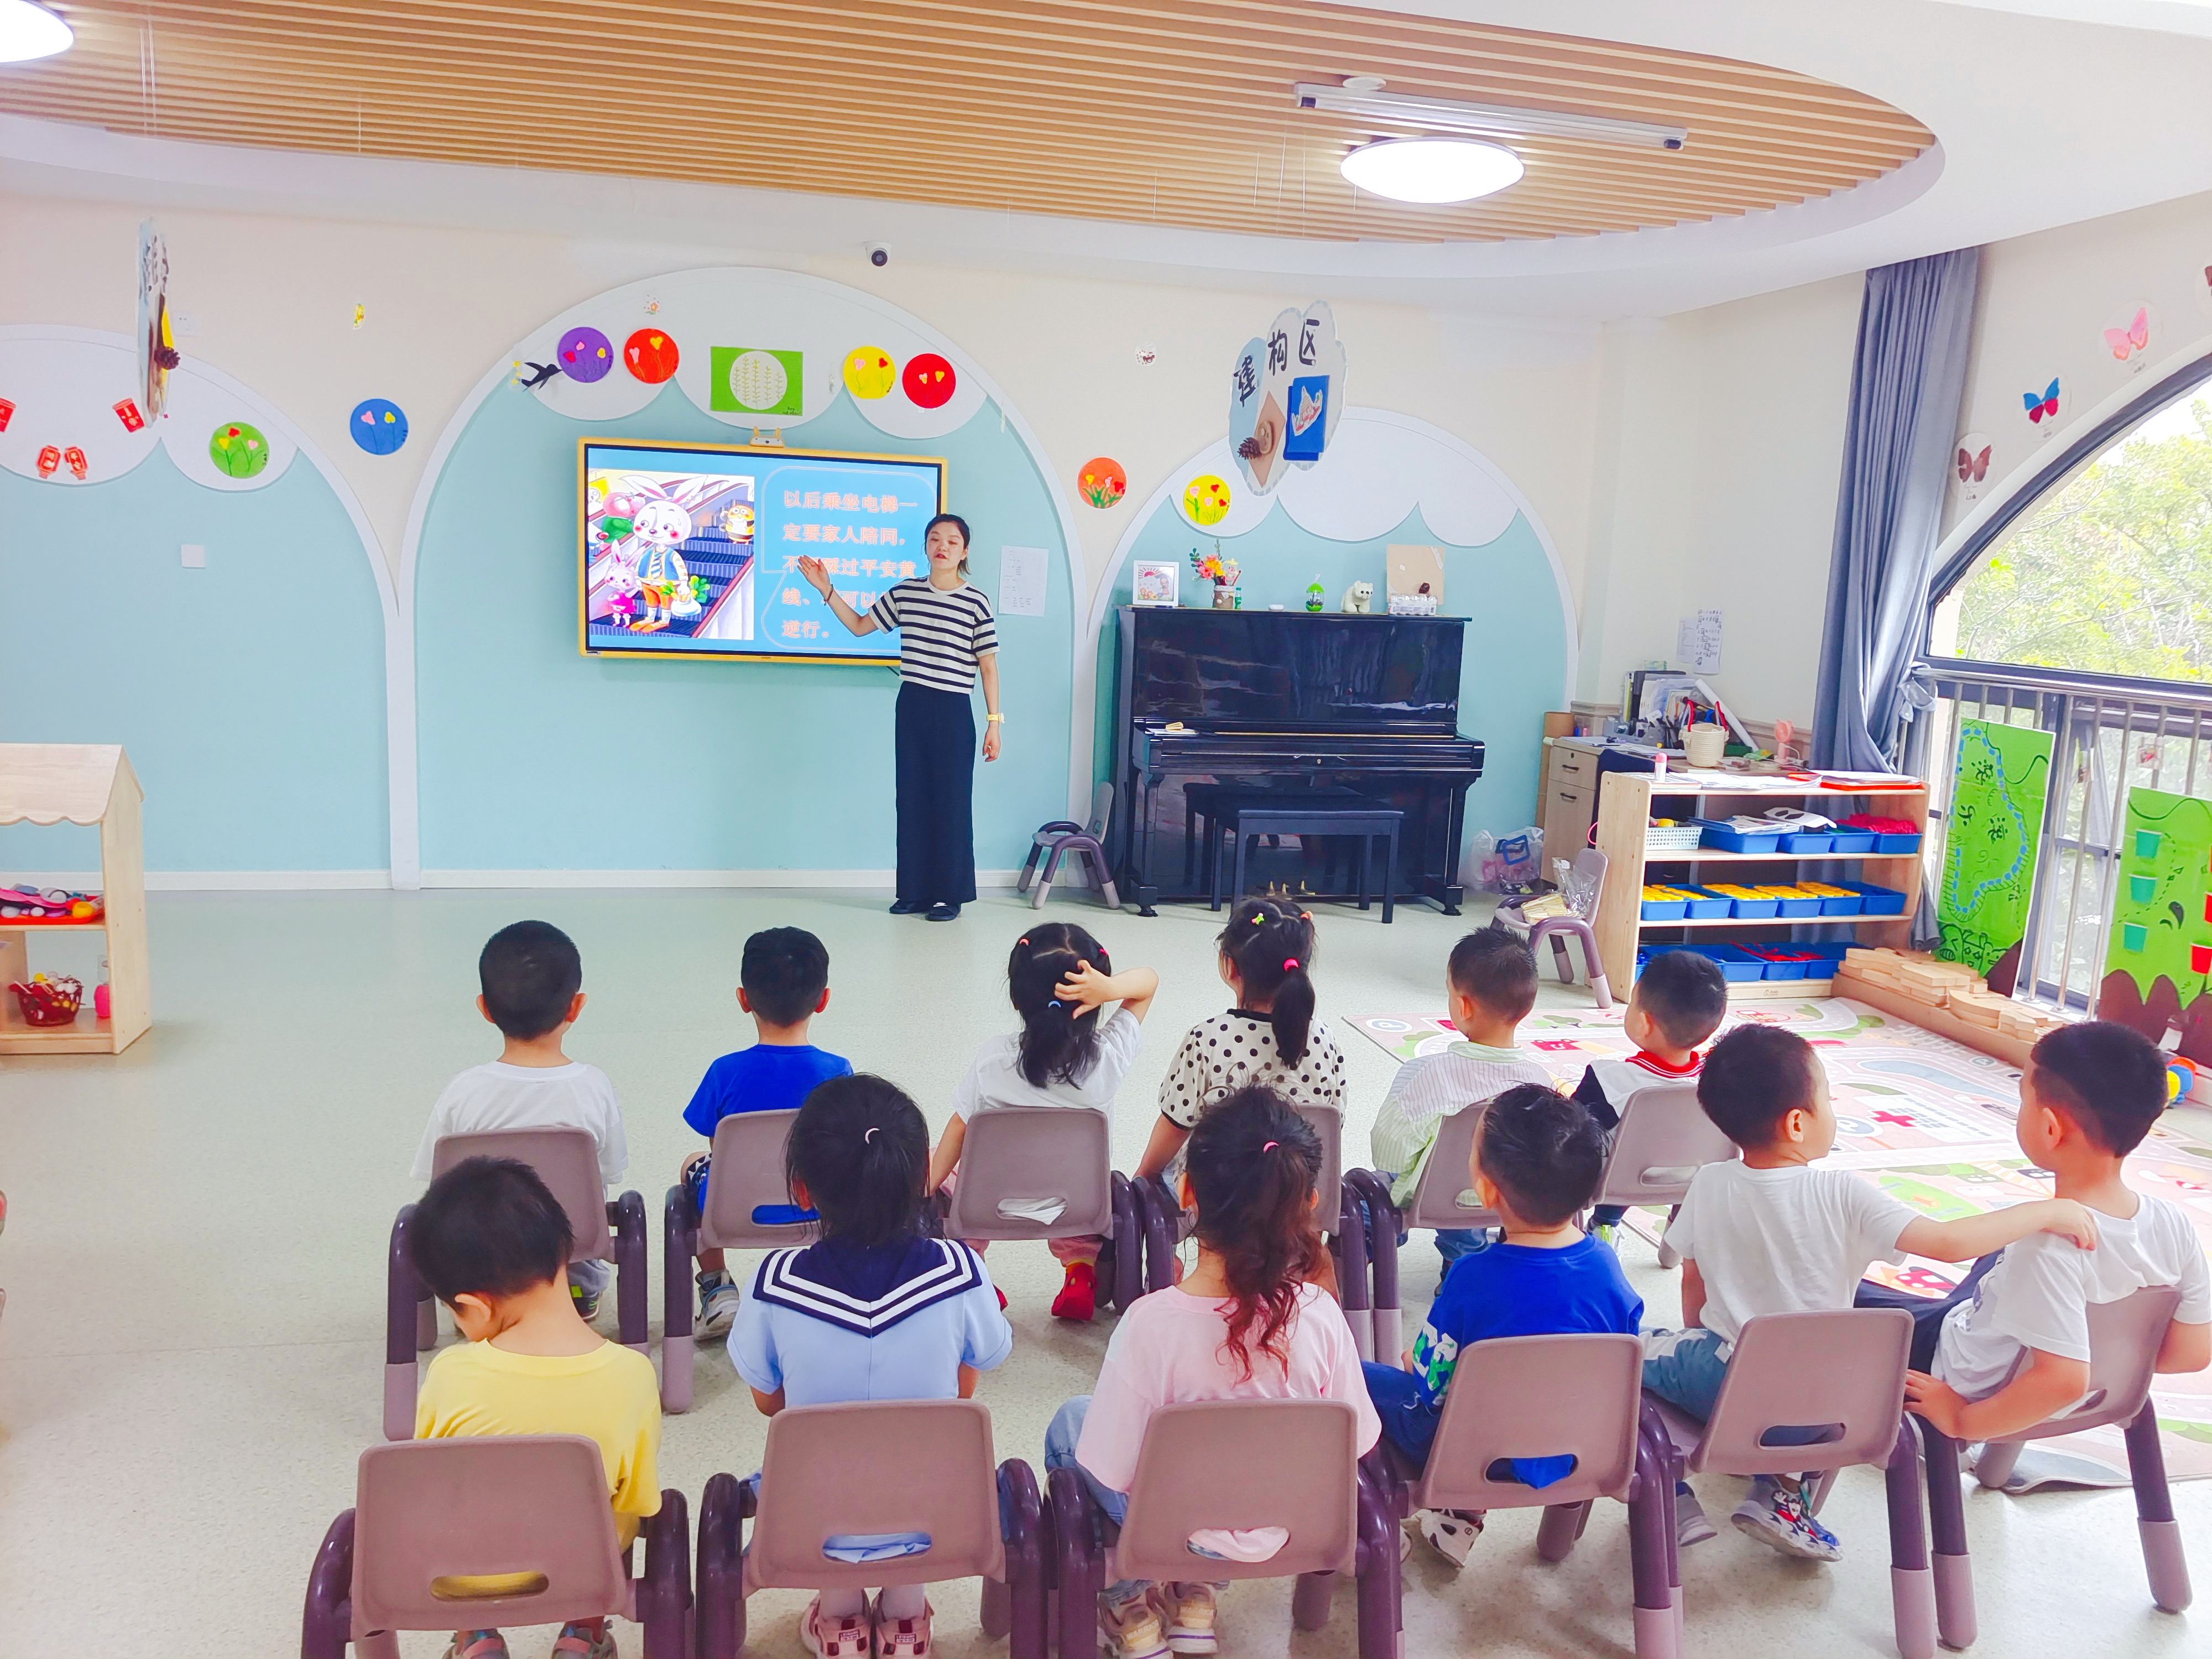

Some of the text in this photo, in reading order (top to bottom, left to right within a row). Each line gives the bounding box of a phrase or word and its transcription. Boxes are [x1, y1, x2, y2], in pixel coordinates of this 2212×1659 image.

[1233, 319, 1320, 408] 建构区
[784, 490, 917, 513] 以后乘坐电梯一
[782, 555, 916, 578] 不踩过平安黄
[782, 587, 885, 608] 线、可以
[782, 620, 829, 638] 逆行。
